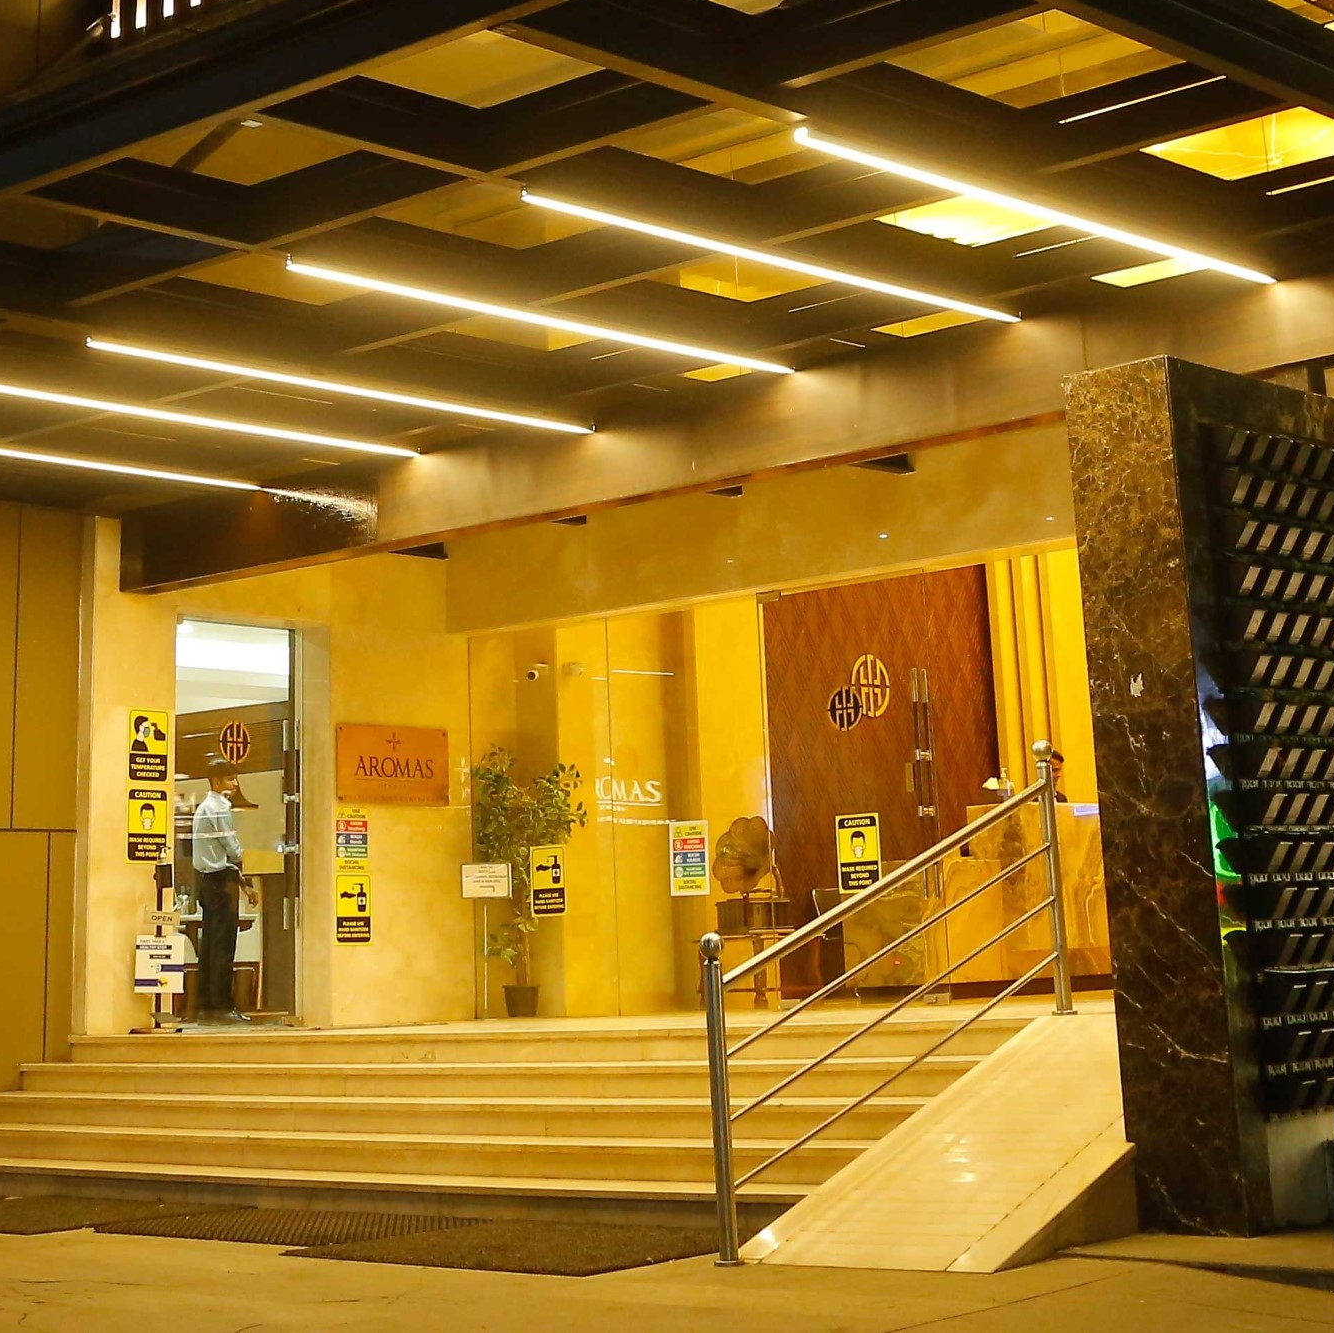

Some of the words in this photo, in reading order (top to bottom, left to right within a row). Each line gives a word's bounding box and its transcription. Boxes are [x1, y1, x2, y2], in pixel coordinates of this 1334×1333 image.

[354, 755, 434, 779] AROMAS
[134, 791, 162, 799] CAUTION
[843, 818, 871, 827] CAUTION
[151, 914, 173, 923] OPEN
